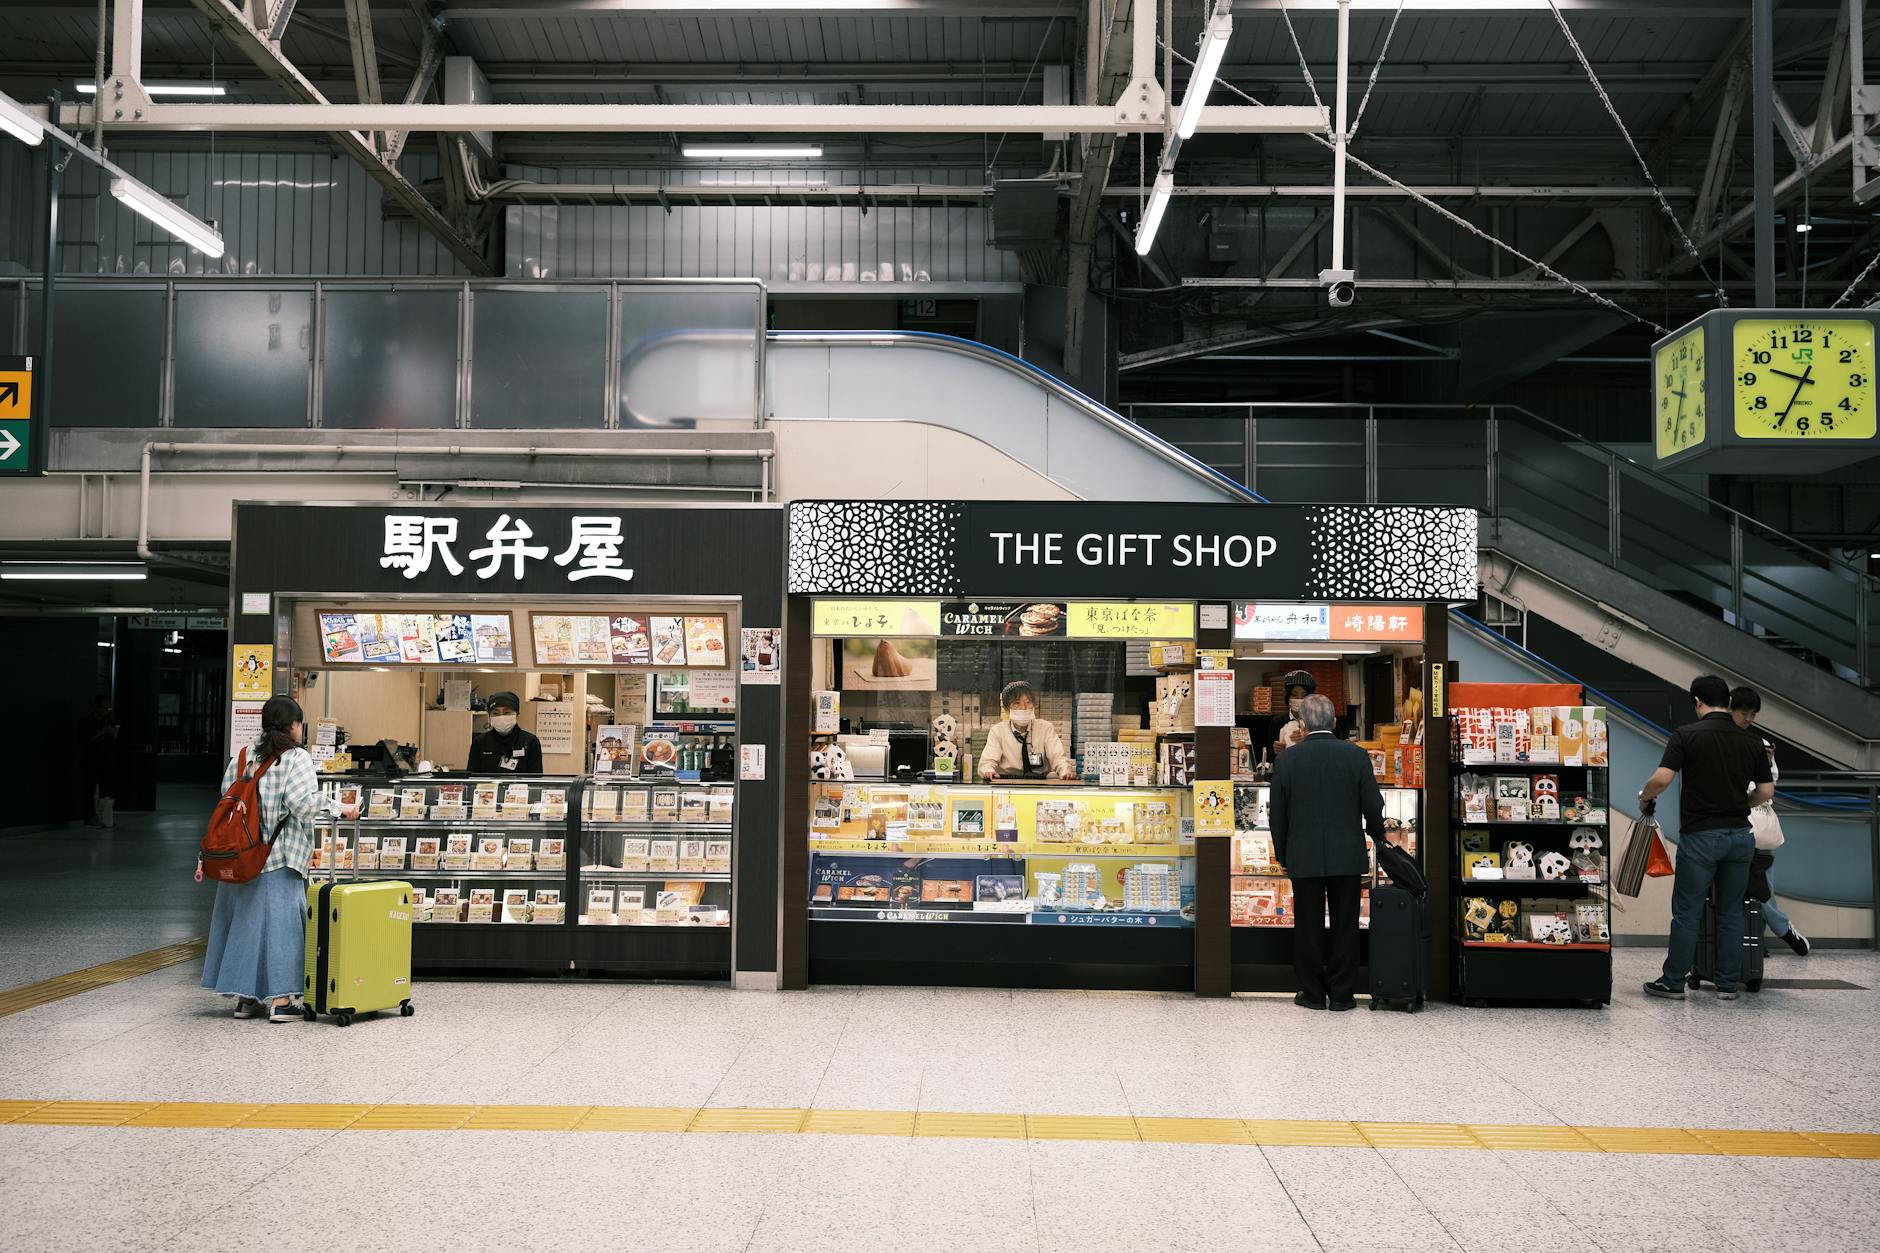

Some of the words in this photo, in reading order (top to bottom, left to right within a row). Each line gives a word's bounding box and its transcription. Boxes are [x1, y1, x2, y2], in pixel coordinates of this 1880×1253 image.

[918, 300, 934, 314] 12
[1772, 336, 1788, 349] 11
[1792, 330, 1812, 342] 12
[1822, 336, 1831, 348] 1
[1752, 352, 1771, 364] 10
[1792, 348, 1813, 361] JR
[1840, 350, 1852, 363] 2
[1744, 372, 1756, 386] 9
[1849, 374, 1862, 387] 3
[1754, 396, 1768, 410] 8
[1838, 398, 1852, 410] 4
[1796, 418, 1809, 430] 6
[1820, 412, 1833, 426] 5
[380, 514, 633, 581] 駅弁屋
[990, 533, 1062, 564] THE
[1077, 534, 1161, 565] GIFT
[1173, 535, 1276, 567] SHOP
[944, 612, 1004, 624] CARAMEL
[1086, 606, 1158, 622] 東京ばな奈
[956, 624, 992, 635] WICH
[1344, 614, 1408, 632] 崎陽軒
[816, 868, 852, 876] CARAMEL
[1070, 915, 1143, 925] シュガーバターの木
